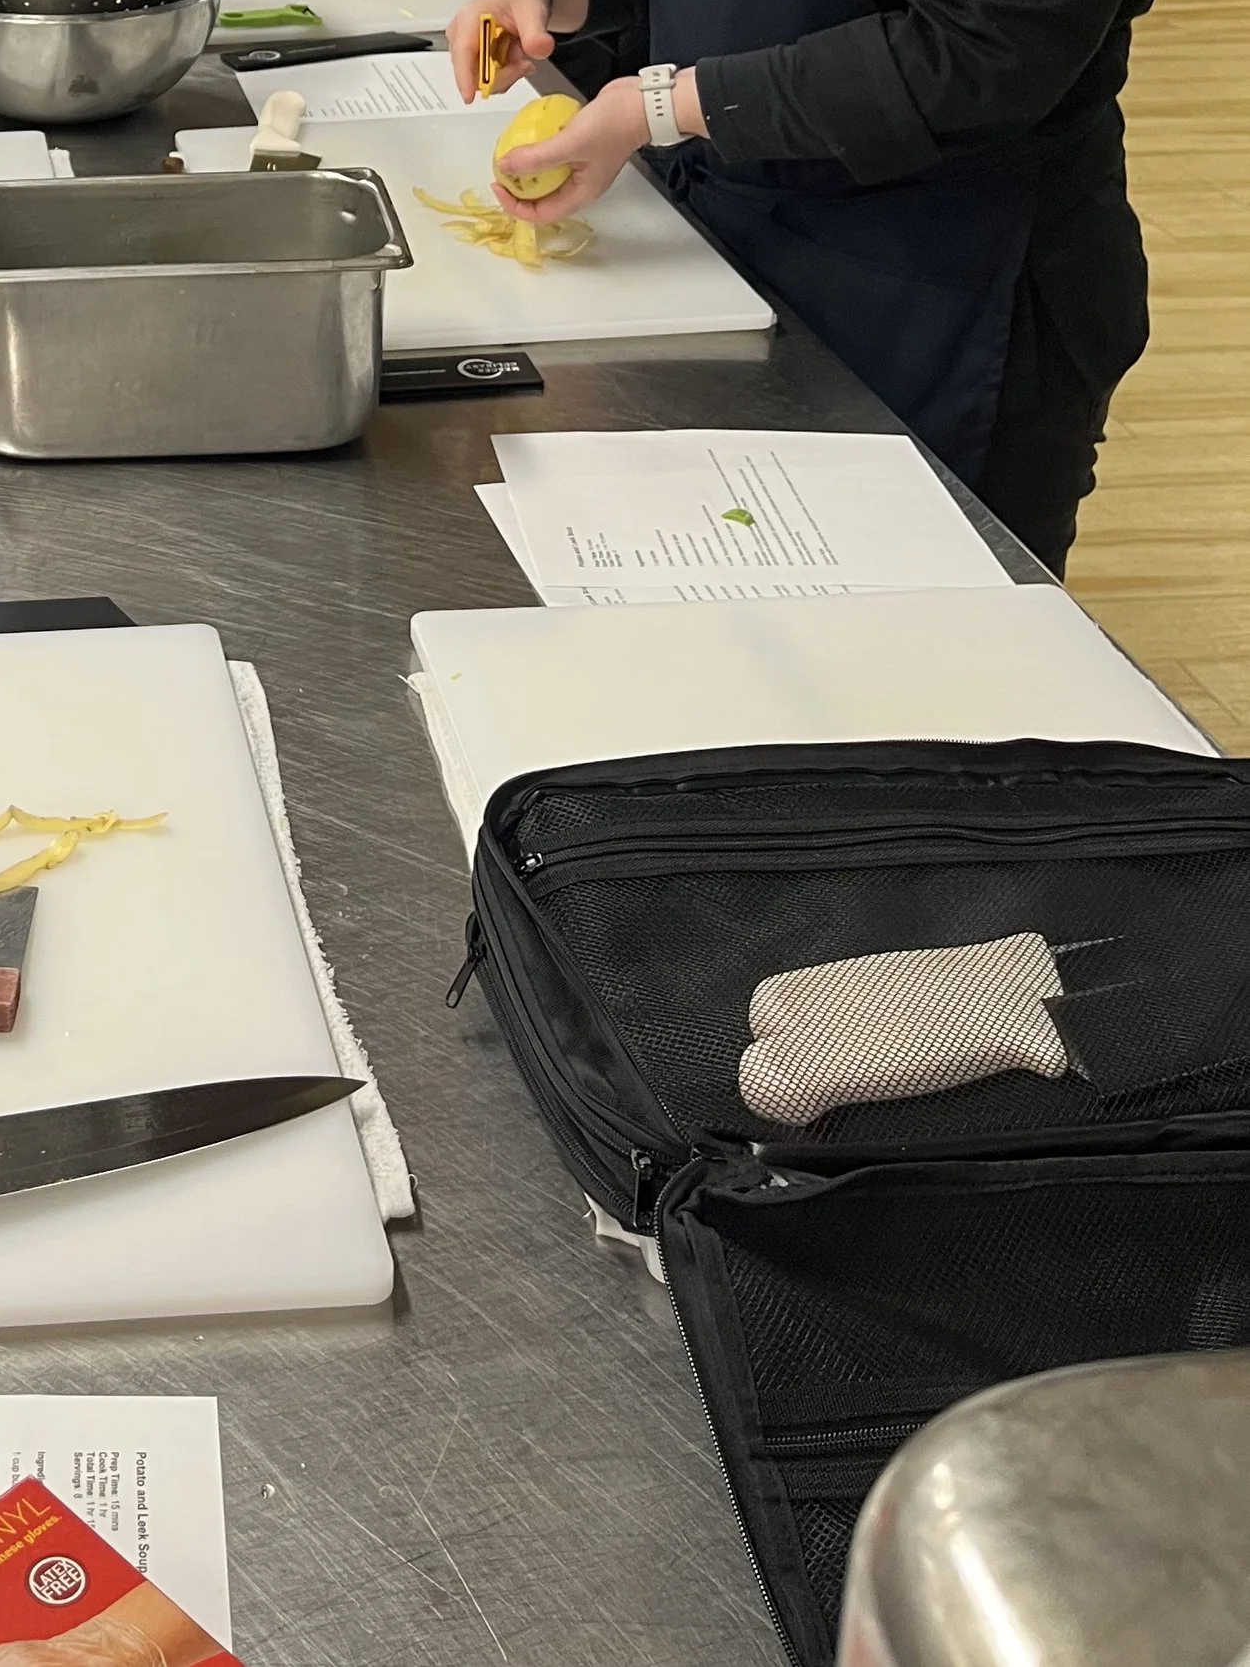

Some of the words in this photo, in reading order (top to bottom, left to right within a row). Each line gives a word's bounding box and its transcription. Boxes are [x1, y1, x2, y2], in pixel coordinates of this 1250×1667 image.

[10, 1457, 20, 1473] cup
[85, 1451, 96, 1473] Total
[97, 1451, 108, 1474] Cook
[109, 1451, 120, 1472] Prep
[135, 1451, 147, 1487] Potato
[110, 1499, 121, 1510] 15
[136, 1489, 149, 1511] and
[85, 1507, 95, 1517] hr
[98, 1508, 108, 1518] hr
[110, 1511, 119, 1532] mins
[23, 1515, 63, 1545] gloves.
[136, 1512, 150, 1541] Leek
[136, 1542, 150, 1574] Soup
[35, 1560, 72, 1590] LATEX
[40, 1567, 83, 1601] FREE
